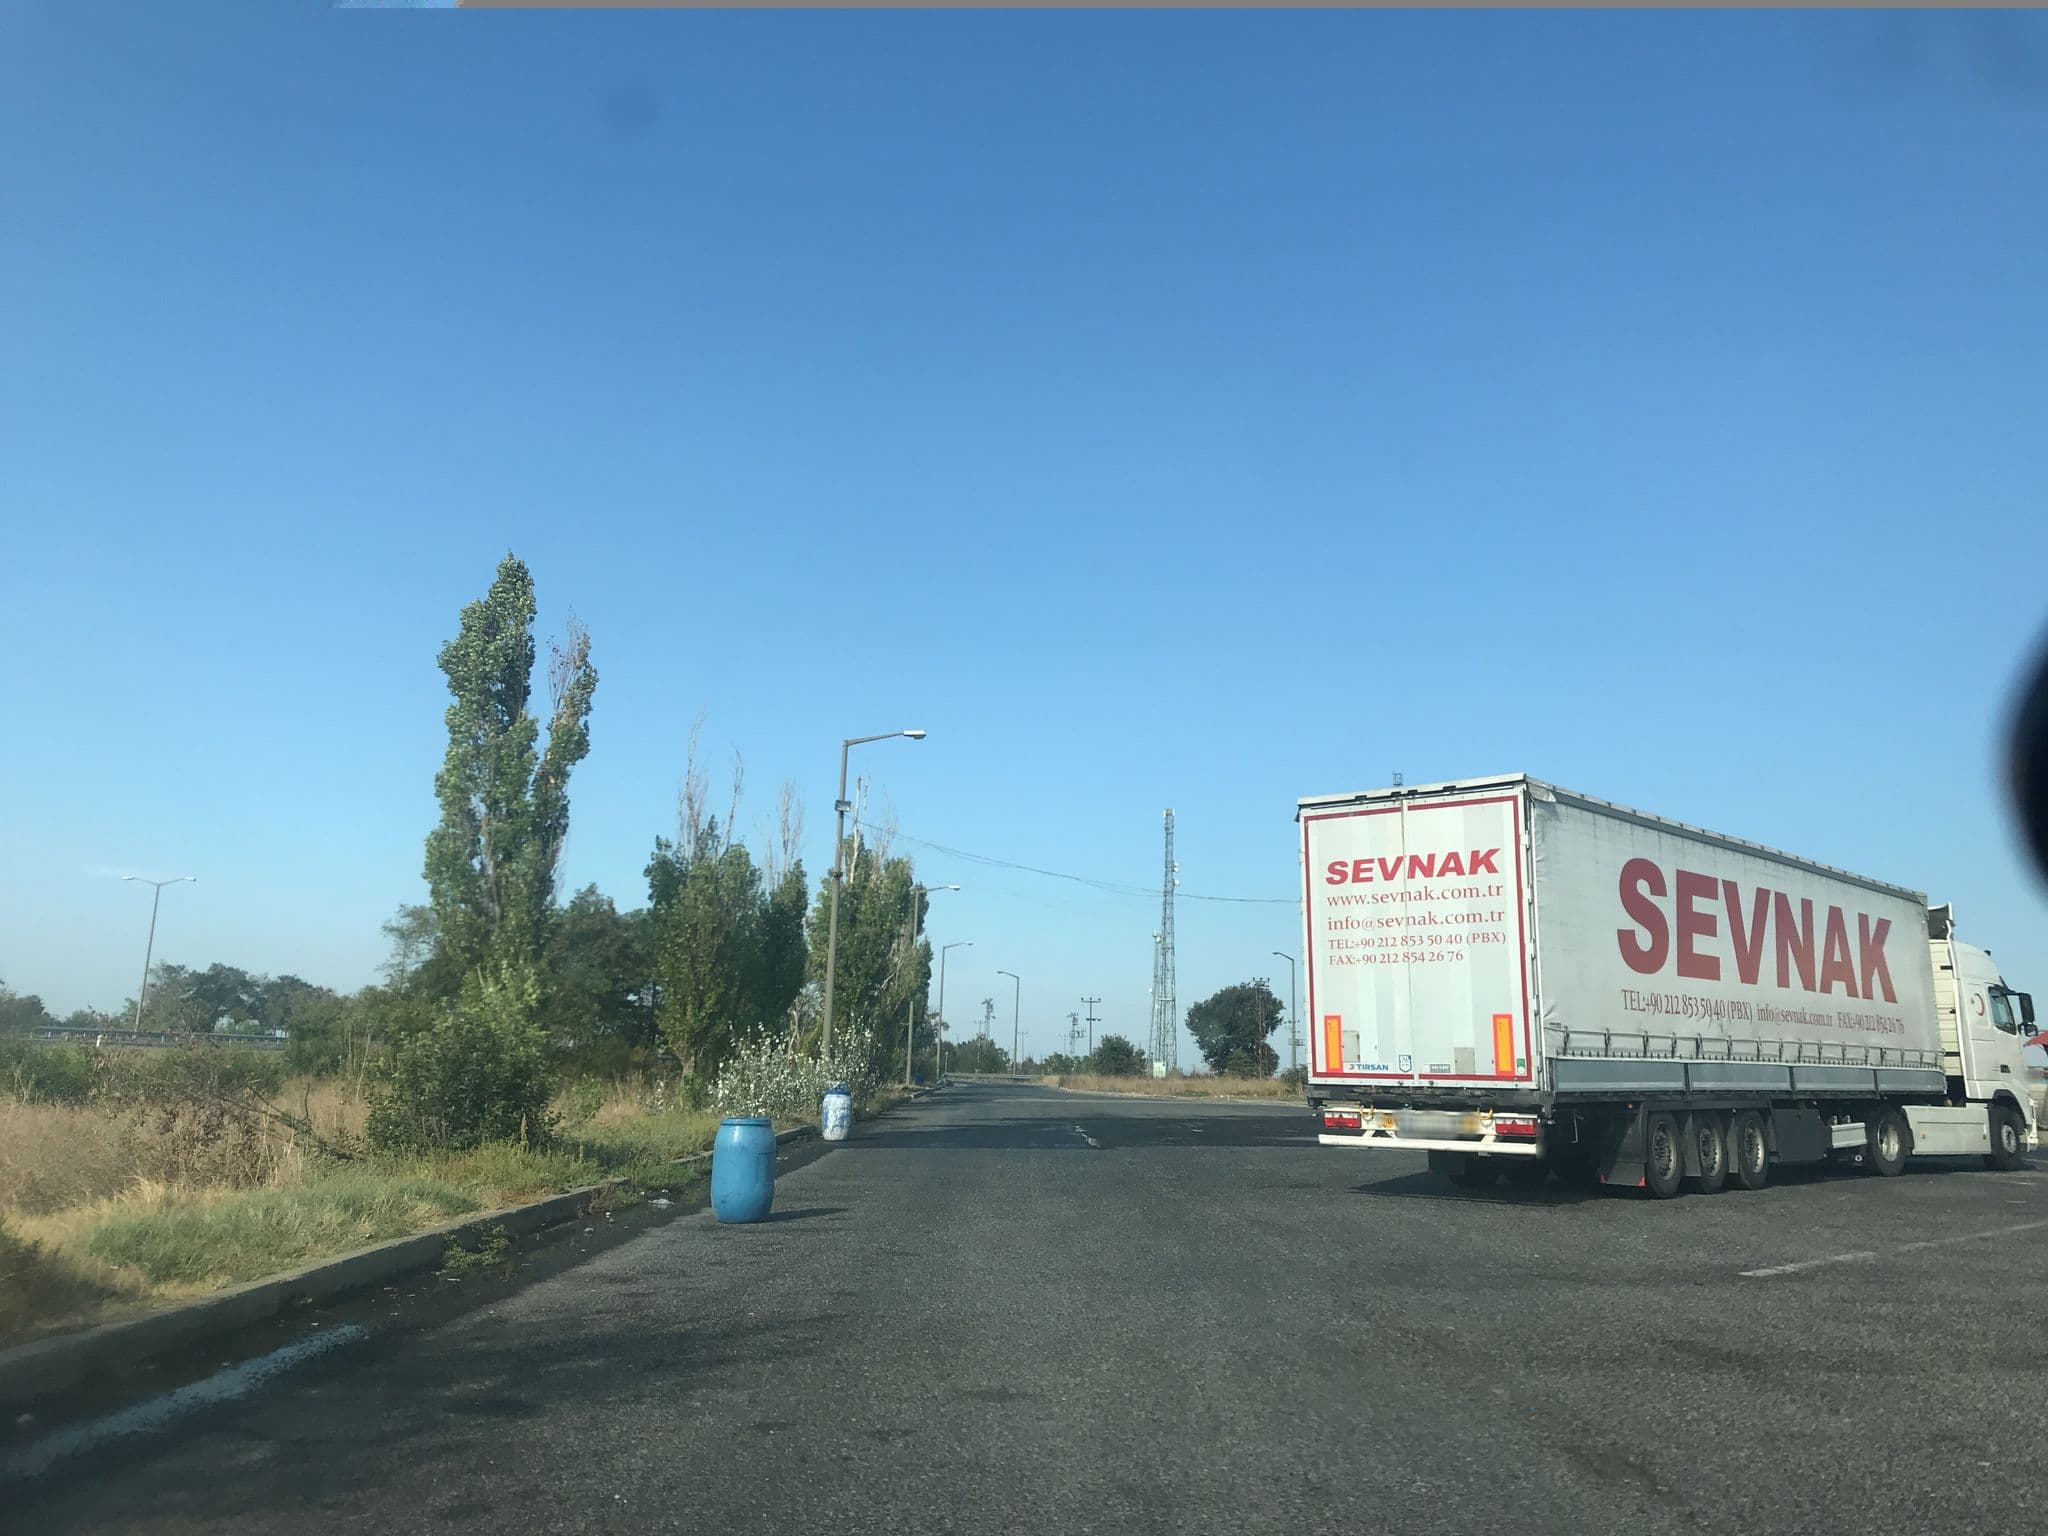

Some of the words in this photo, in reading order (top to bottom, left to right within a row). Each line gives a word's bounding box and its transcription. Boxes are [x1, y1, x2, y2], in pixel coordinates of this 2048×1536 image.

[1325, 848, 1501, 885] SEVNAK
[1327, 884, 1504, 907] www.sevnak.com.tr
[1328, 910, 1505, 931] info@sevnak.com.tr
[1617, 857, 1898, 1004] SEVNAK
[1377, 936, 1397, 948] 212
[1400, 935, 1424, 947] 853
[1427, 934, 1443, 946] 50
[1446, 933, 1463, 945] 40
[1466, 931, 1506, 945] (PBX)
[1379, 953, 1399, 964] 212
[1402, 951, 1425, 964] 854
[1428, 950, 1444, 962] 26
[1447, 950, 1463, 962] 76
[1664, 994, 1681, 1015] 212
[1682, 996, 1699, 1018] 853
[1700, 999, 1713, 1019] 50
[1713, 1000, 1726, 1020] 40
[1727, 1000, 1753, 1025] (PBX)
[1757, 1003, 1833, 1027] info@sevnak.com.tr
[1356, 1063, 1389, 1071] TIRSAN
